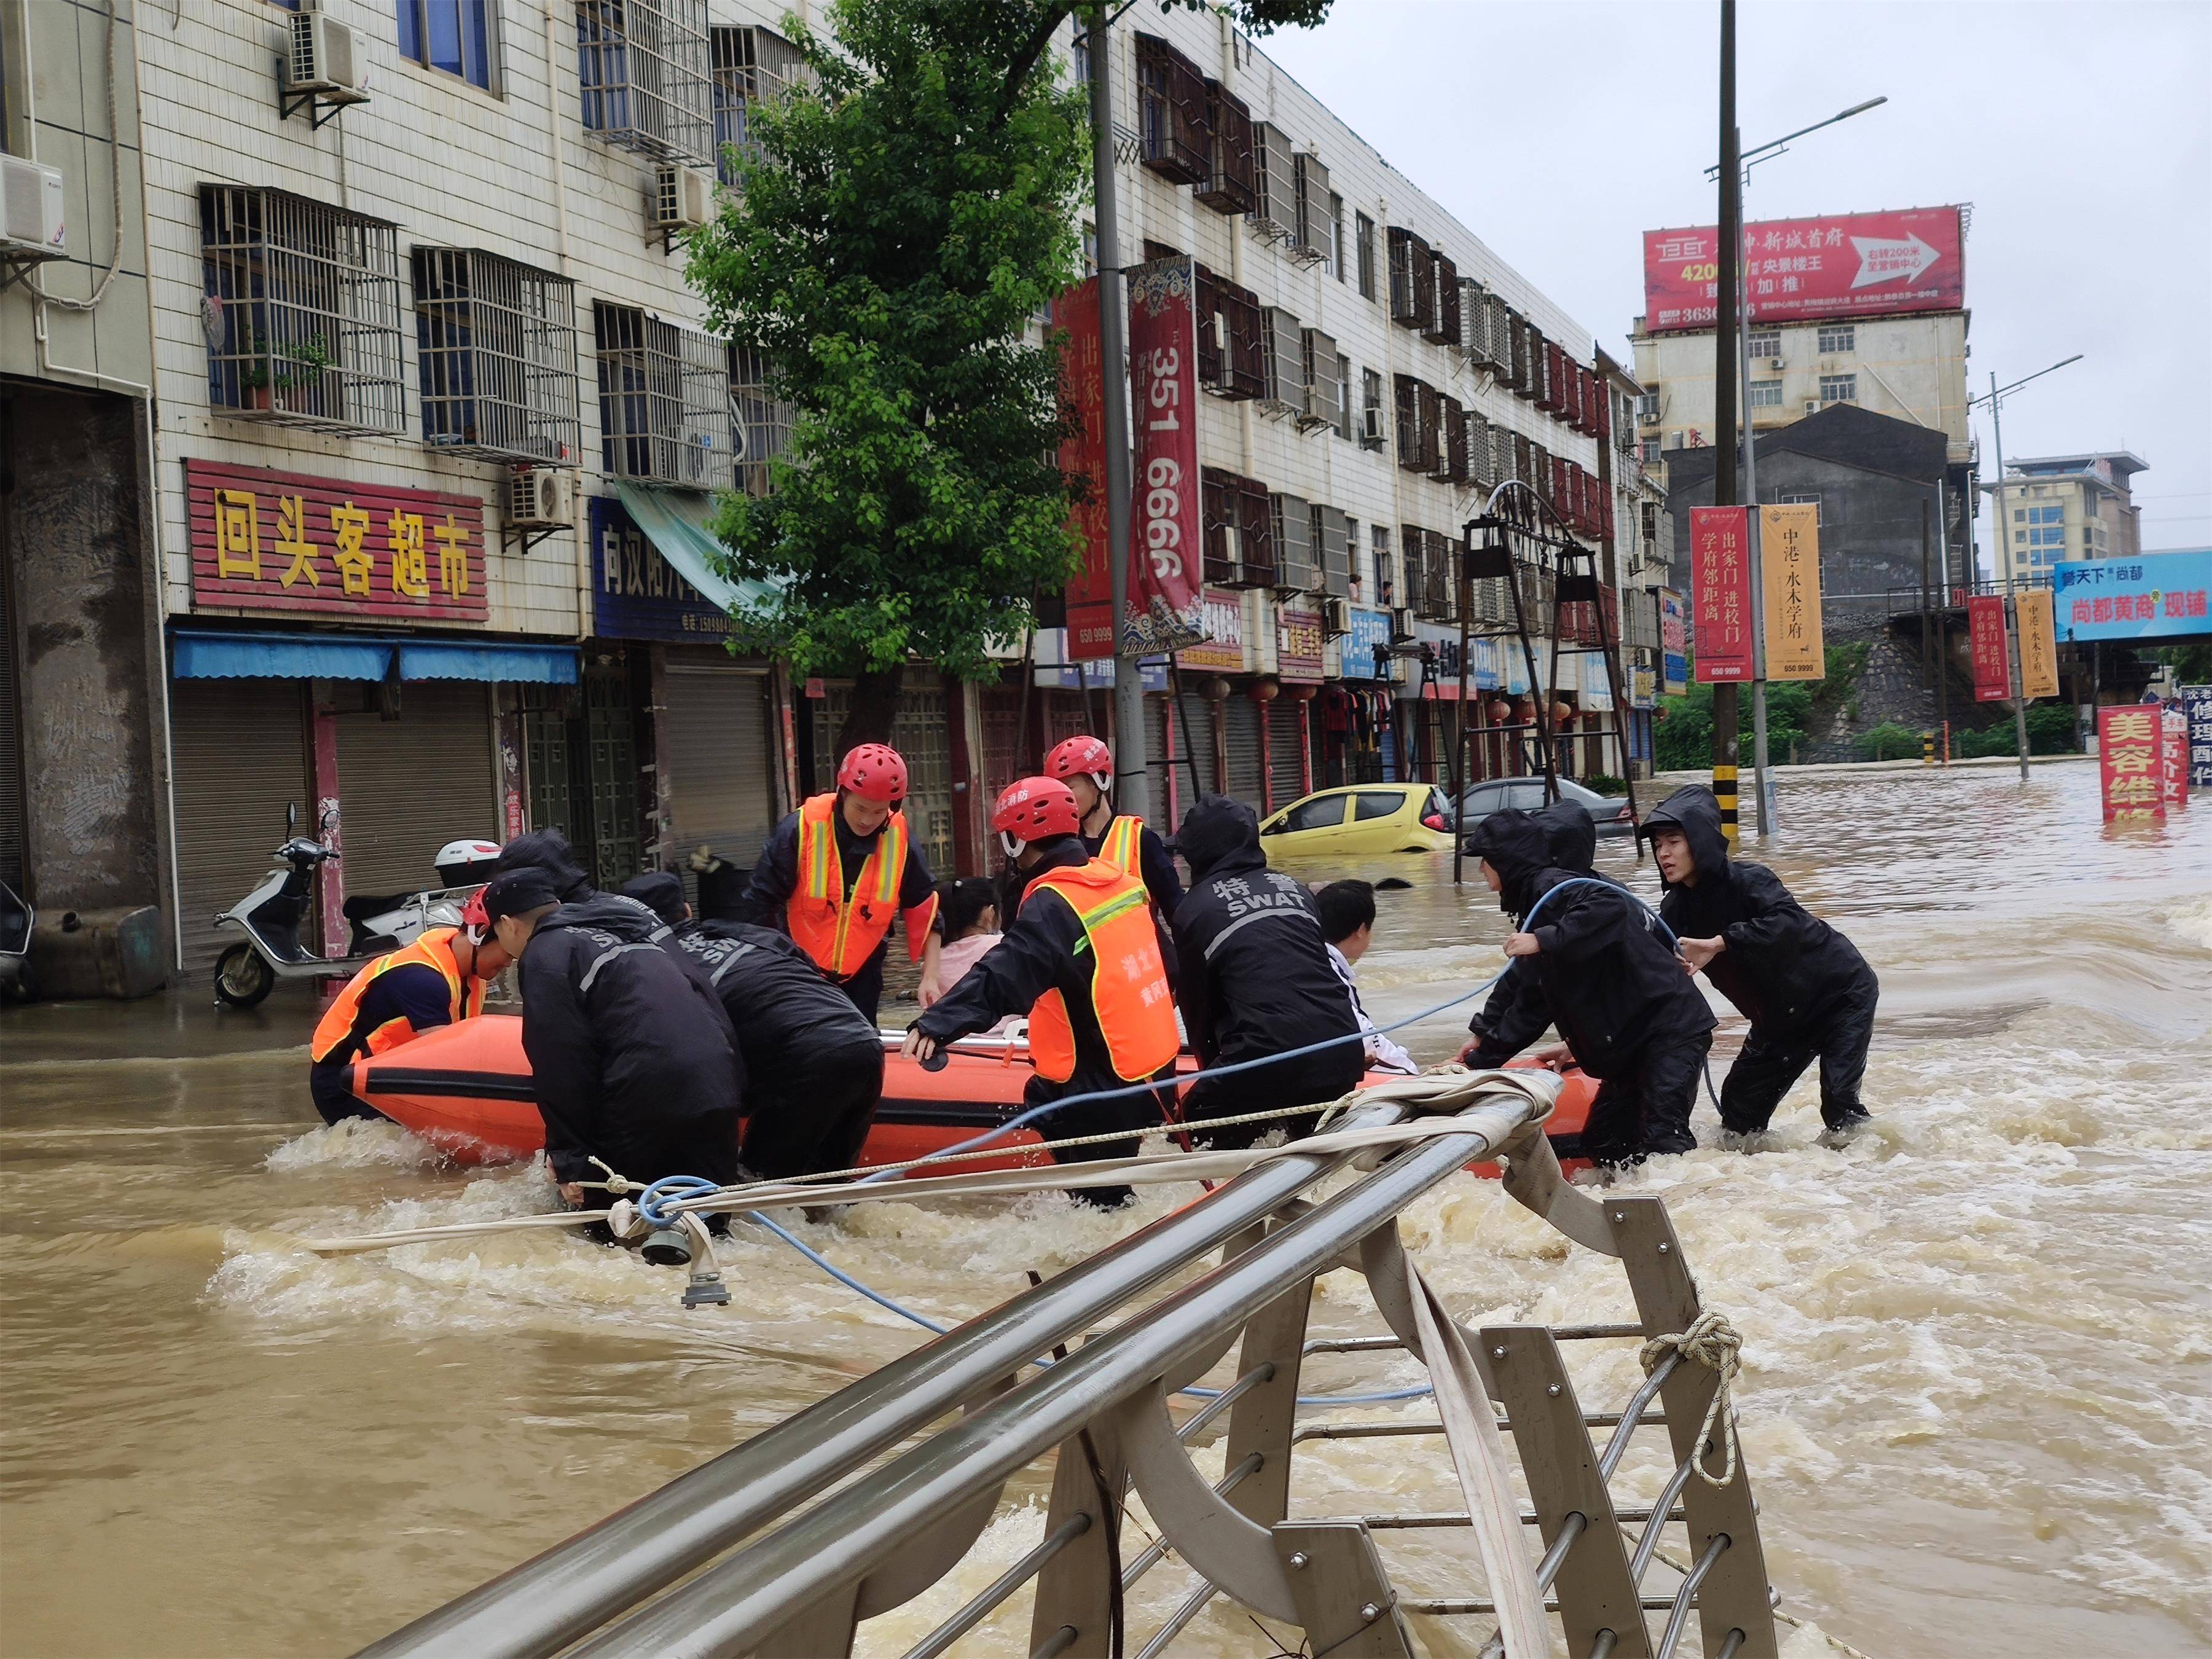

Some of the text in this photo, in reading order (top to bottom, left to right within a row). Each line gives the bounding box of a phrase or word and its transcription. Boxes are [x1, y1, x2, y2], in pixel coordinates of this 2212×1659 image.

[1763, 255, 1822, 274] 央景楼王
[1868, 245, 1921, 259] 右转200米
[1868, 257, 1922, 272] 至营销中心
[1081, 333, 1102, 445] 出家门
[1147, 347, 1182, 579] 351 6666
[213, 488, 471, 600] 回头客超市
[1701, 532, 1719, 621] 学府邻距离
[1722, 531, 1740, 643] 出家门 进校门
[1783, 528, 1803, 640] 中港·水木学府
[2116, 565, 2143, 581] 尚都
[2072, 594, 2155, 624] 尚都黄商
[2164, 590, 2207, 618] 现铺
[1079, 627, 1113, 643] 650 9999
[1212, 872, 1300, 901] 特警
[1226, 892, 1306, 917] SWAT
